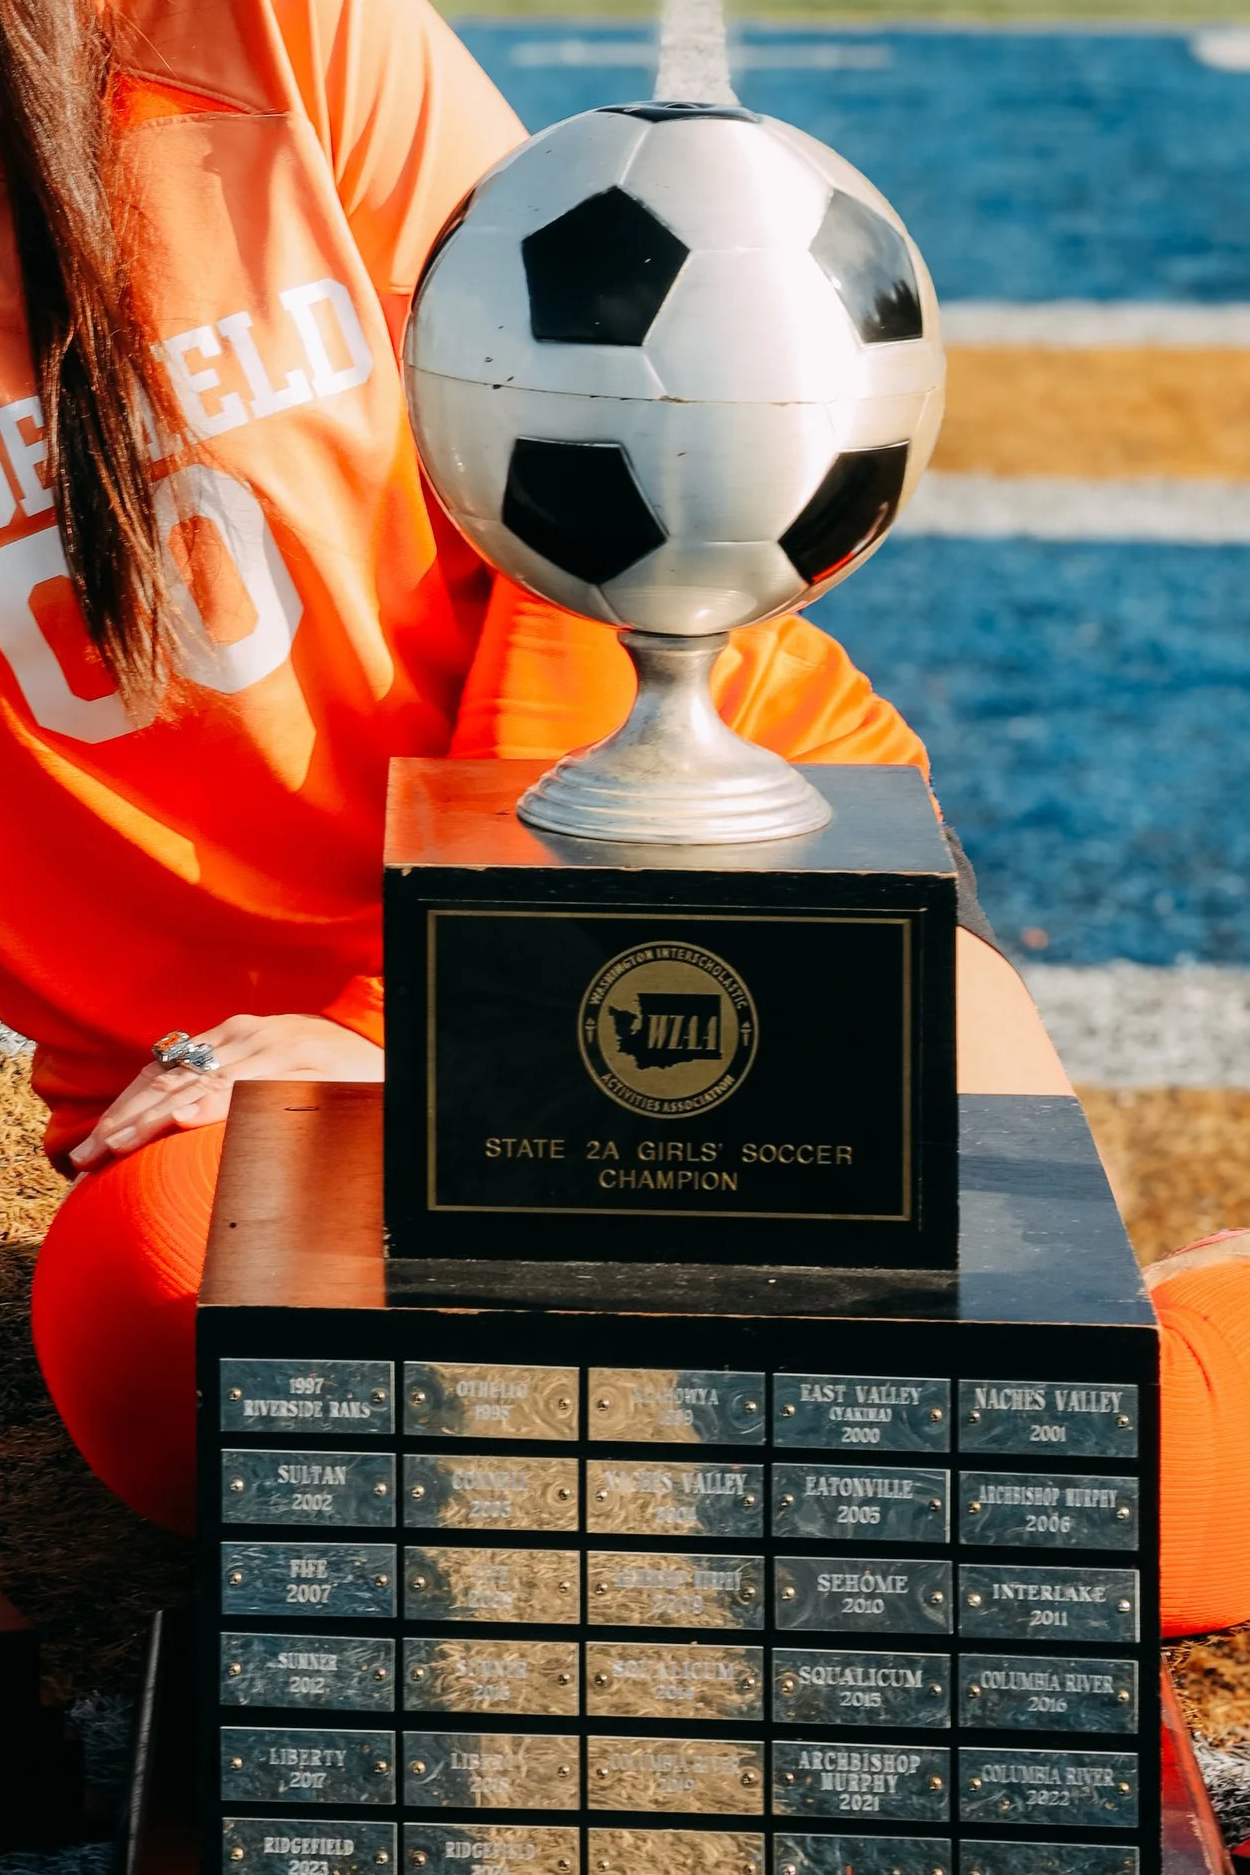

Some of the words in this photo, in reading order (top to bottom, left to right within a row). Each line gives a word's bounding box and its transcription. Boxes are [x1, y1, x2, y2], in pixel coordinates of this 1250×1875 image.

[589, 949, 654, 1005] WASHINGTON
[656, 948, 748, 1010] INTERSCHOLASTIC
[601, 1073, 661, 1112] ACTIVITIES
[662, 1075, 735, 1113] ASSOCIATION
[485, 1137, 565, 1159] STATE
[586, 1140, 620, 1160] 2A
[637, 1141, 724, 1162] GIRLS'
[741, 1143, 853, 1165] SOCCER
[599, 1169, 739, 1191] CHAMPION
[289, 1377, 325, 1395] 1997
[800, 1383, 847, 1404] EAST
[855, 1386, 922, 1406] VALLEY
[243, 1400, 323, 1417] RIVERSIDE
[974, 1387, 1046, 1411] NACHES
[1054, 1390, 1123, 1414] VALLEY
[829, 1406, 892, 1423] (YAKIMA)
[840, 1426, 881, 1444] 2000
[1029, 1424, 1066, 1443] 2001
[277, 1465, 347, 1485] SULTAN
[681, 1472, 748, 1495] VALLEY
[805, 1476, 914, 1499] EATONVILLE
[978, 1484, 1060, 1506] ARCHBISHOP
[1065, 1487, 1118, 1508] MURPHY
[291, 1493, 333, 1511] 2002
[836, 1505, 881, 1525] 2005
[1025, 1514, 1071, 1533] 2006
[289, 1559, 328, 1579] FIFE
[285, 1584, 333, 1603] 2007
[816, 1573, 909, 1594] SEHOME
[992, 1583, 1107, 1603] INTERLAKE
[841, 1597, 885, 1614] 2010
[1030, 1609, 1068, 1627] 2011
[276, 1652, 338, 1671] SUMNER
[288, 1676, 326, 1694] 2012
[798, 1665, 924, 1689] SQUALICUM
[980, 1670, 1059, 1692] COLUMBIA
[1065, 1674, 1114, 1694] RIVER
[839, 1691, 882, 1708] 2015
[1027, 1696, 1068, 1713] 2016
[269, 1747, 347, 1767] LIBERTY
[798, 1750, 922, 1774] ARCHBISHOP
[289, 1771, 327, 1788] 2017
[820, 1772, 899, 1794] MURPHY
[981, 1763, 1063, 1785] COLUMBIA
[1067, 1767, 1115, 1787] RIVER
[839, 1795, 880, 1812] 2021
[1025, 1789, 1070, 1806] 2022
[263, 1836, 355, 1857] RIDGEFIELD
[287, 1859, 330, 1875] 2023
